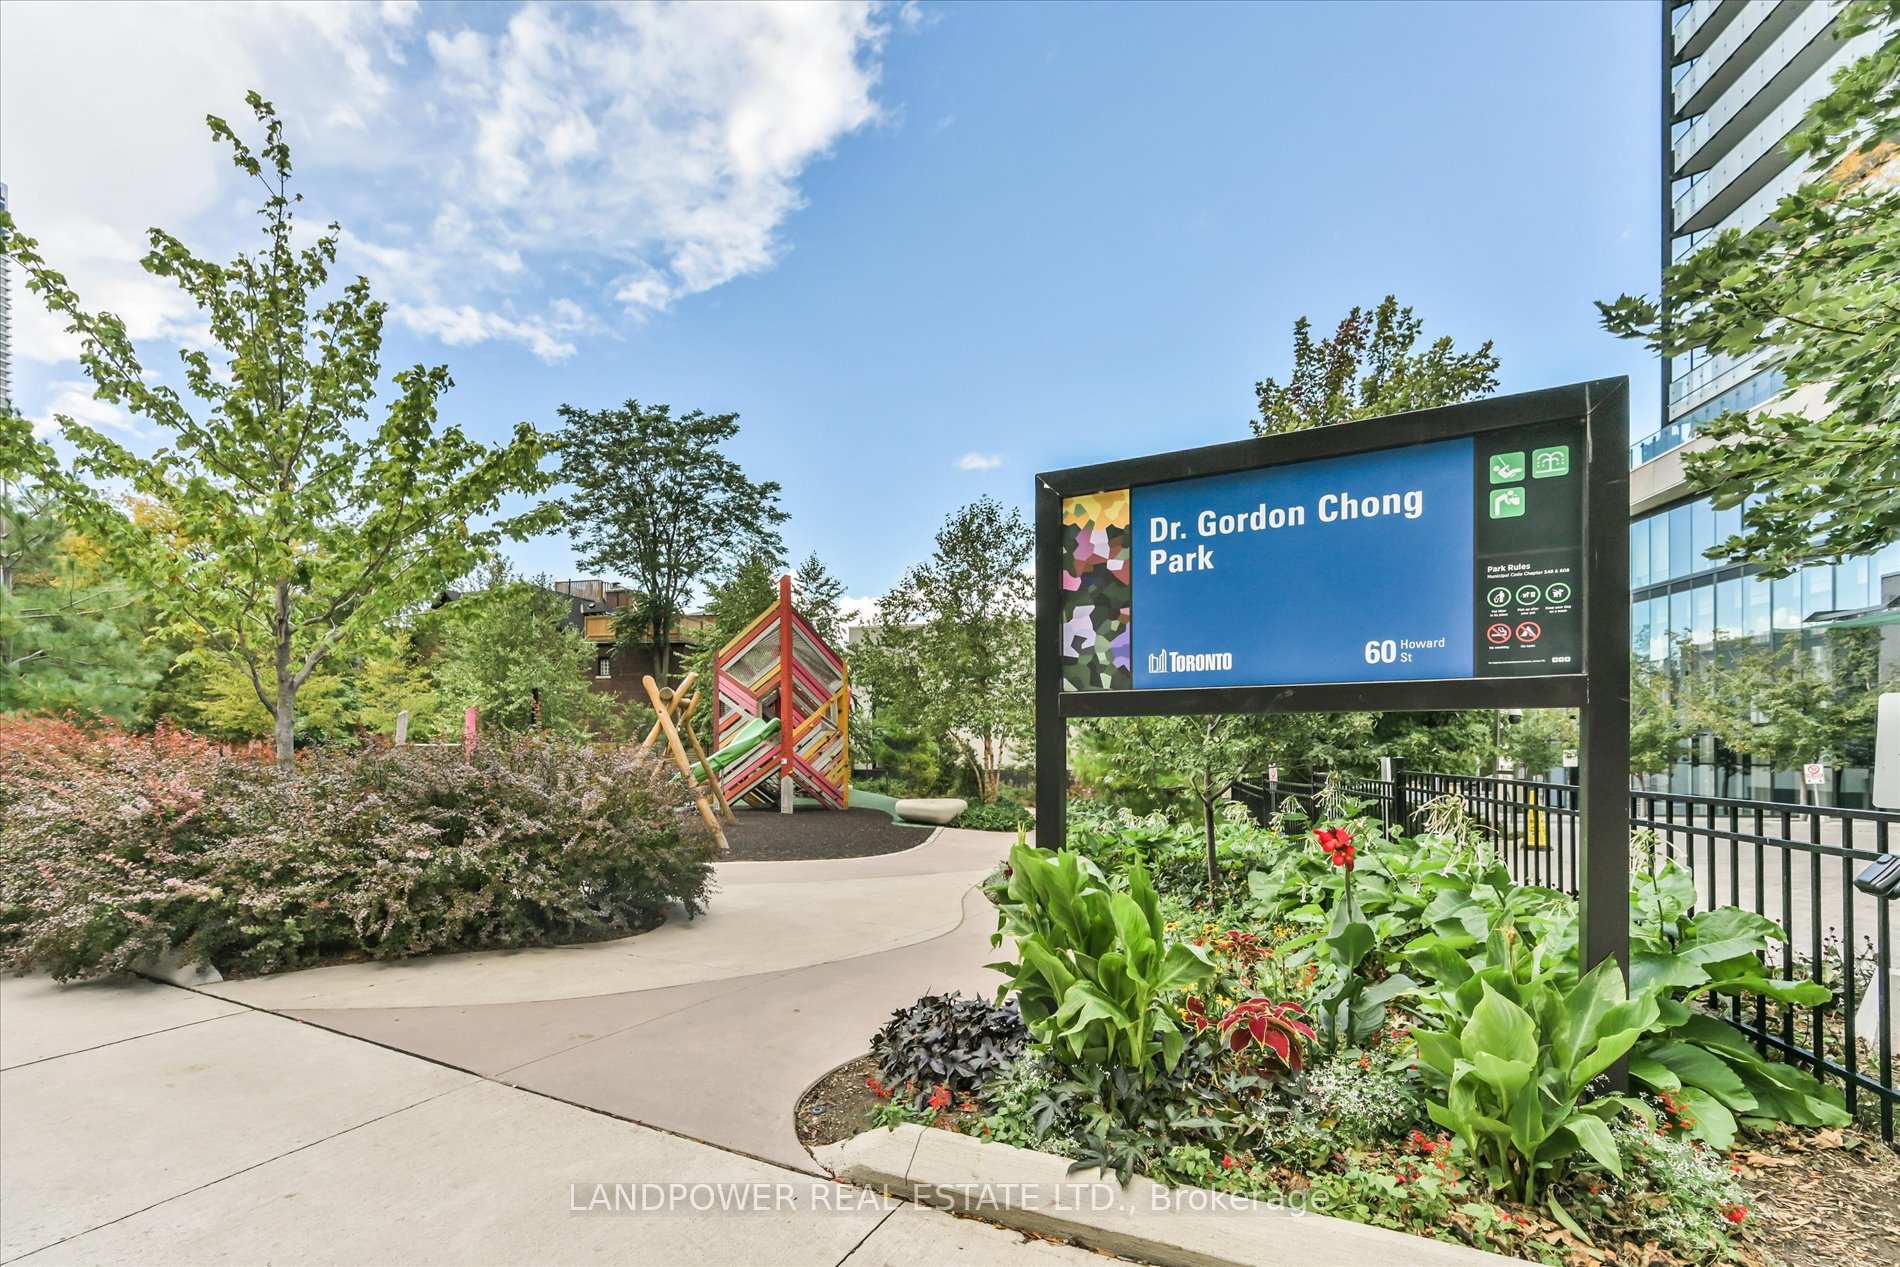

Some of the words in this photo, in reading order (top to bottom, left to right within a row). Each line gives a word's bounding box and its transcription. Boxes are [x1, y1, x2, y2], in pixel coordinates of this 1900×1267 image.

[1150, 517, 1187, 543] Dr.
[1197, 503, 1305, 537] Gordon
[1318, 490, 1423, 523] Chong
[1150, 545, 1215, 575] Park
[1487, 565, 1506, 573] Park
[1508, 563, 1531, 571] Rules
[1169, 651, 1233, 673] TORONTO
[1364, 639, 1397, 664] 60
[1400, 637, 1446, 650] Howard
[1400, 652, 1413, 663] St
